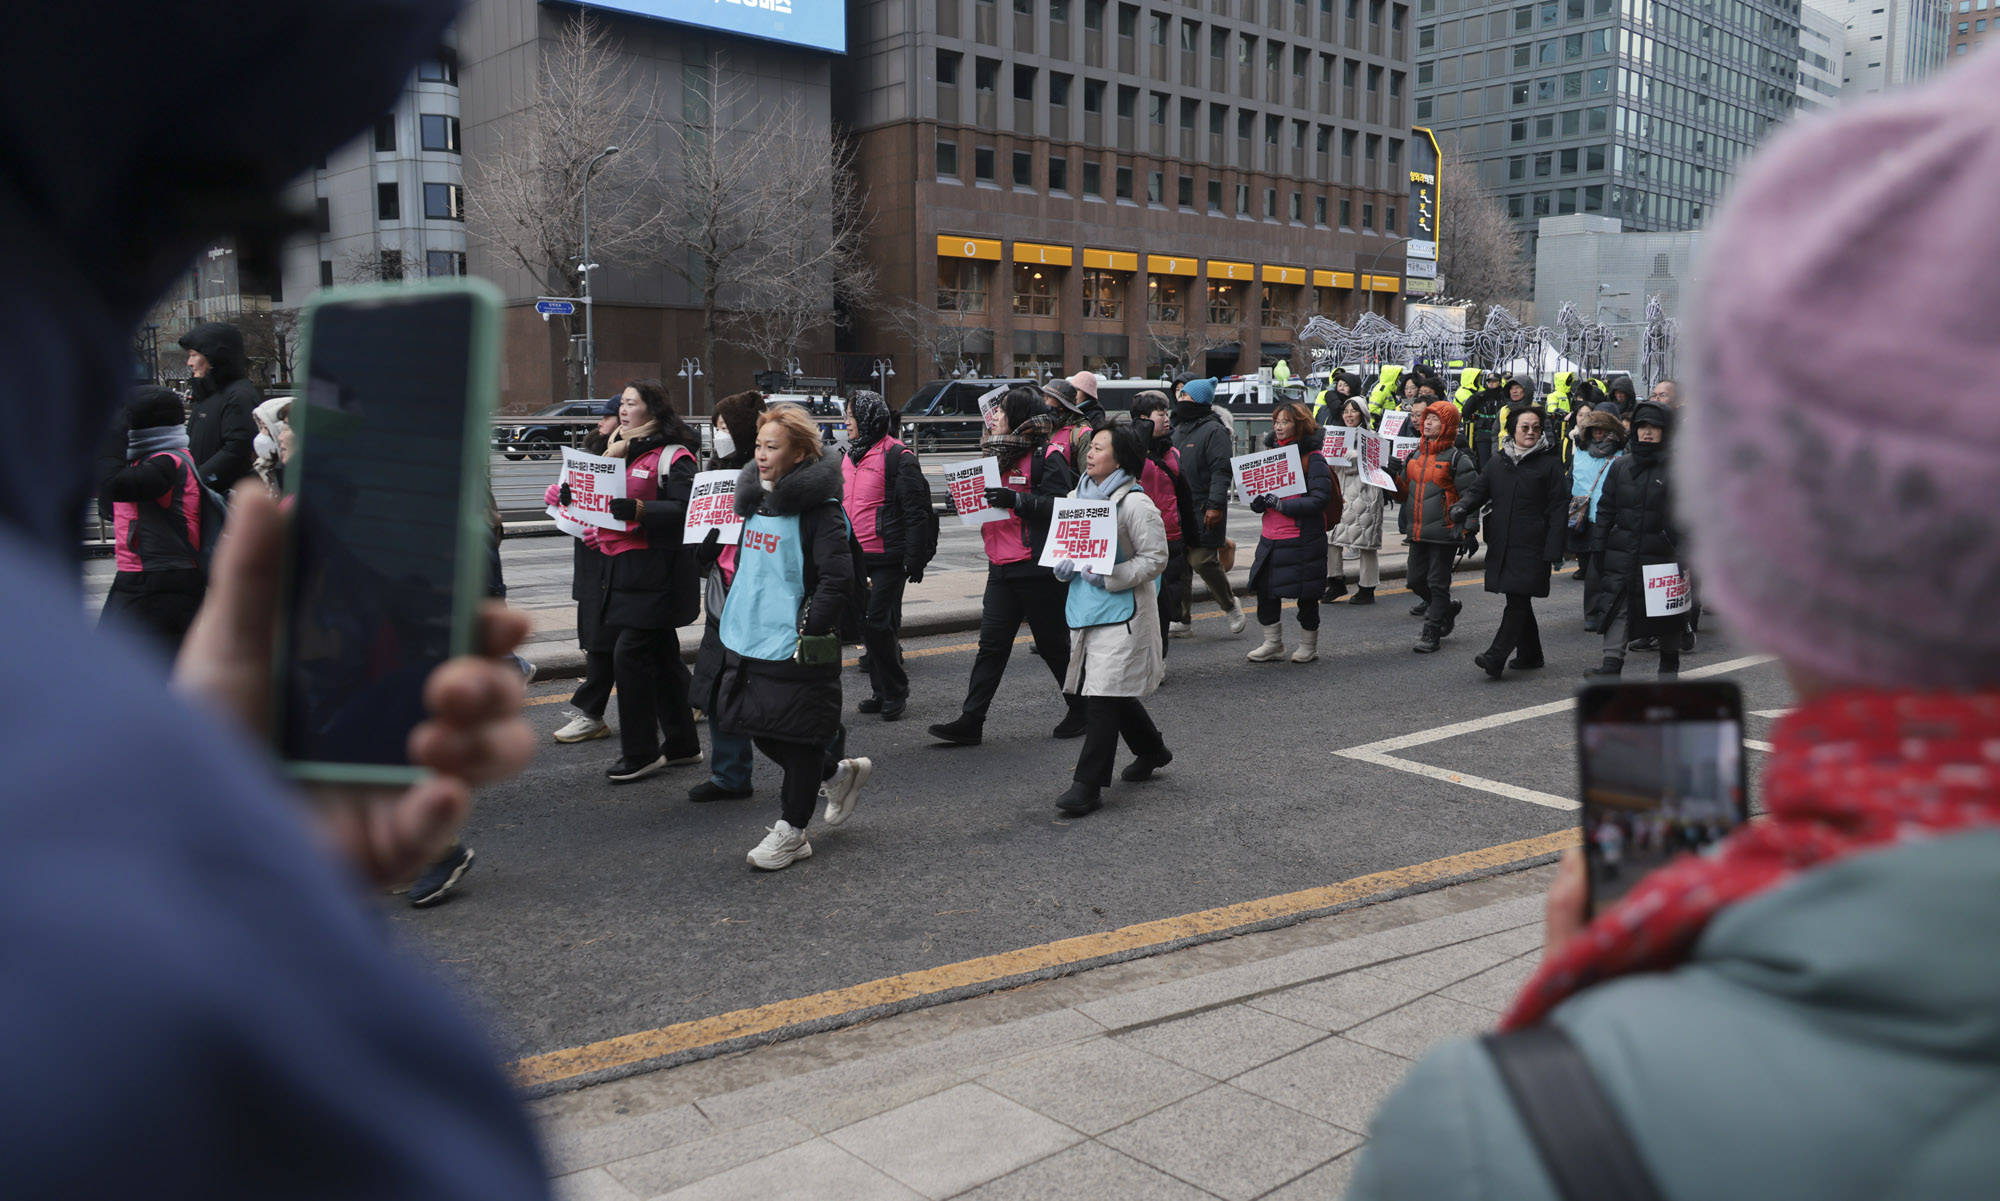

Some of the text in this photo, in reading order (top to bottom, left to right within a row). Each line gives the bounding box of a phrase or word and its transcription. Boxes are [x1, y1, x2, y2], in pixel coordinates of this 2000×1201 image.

[1324, 436, 1345, 447] 프를
[1322, 447, 1348, 458] 한다!
[589, 462, 616, 474] 주권유린
[1242, 460, 1288, 484] 트럼프를
[568, 470, 595, 492] 미국을
[948, 476, 985, 498] 럼프를
[1245, 472, 1296, 496] 규탄한다!
[714, 494, 735, 510] 대통
[1086, 507, 1110, 518] 주권유린
[1055, 520, 1091, 540] 미국을
[745, 529, 781, 554] 진보당
[1053, 539, 1109, 559] 규탄한다!
[1649, 574, 1682, 589] 탄한다!
